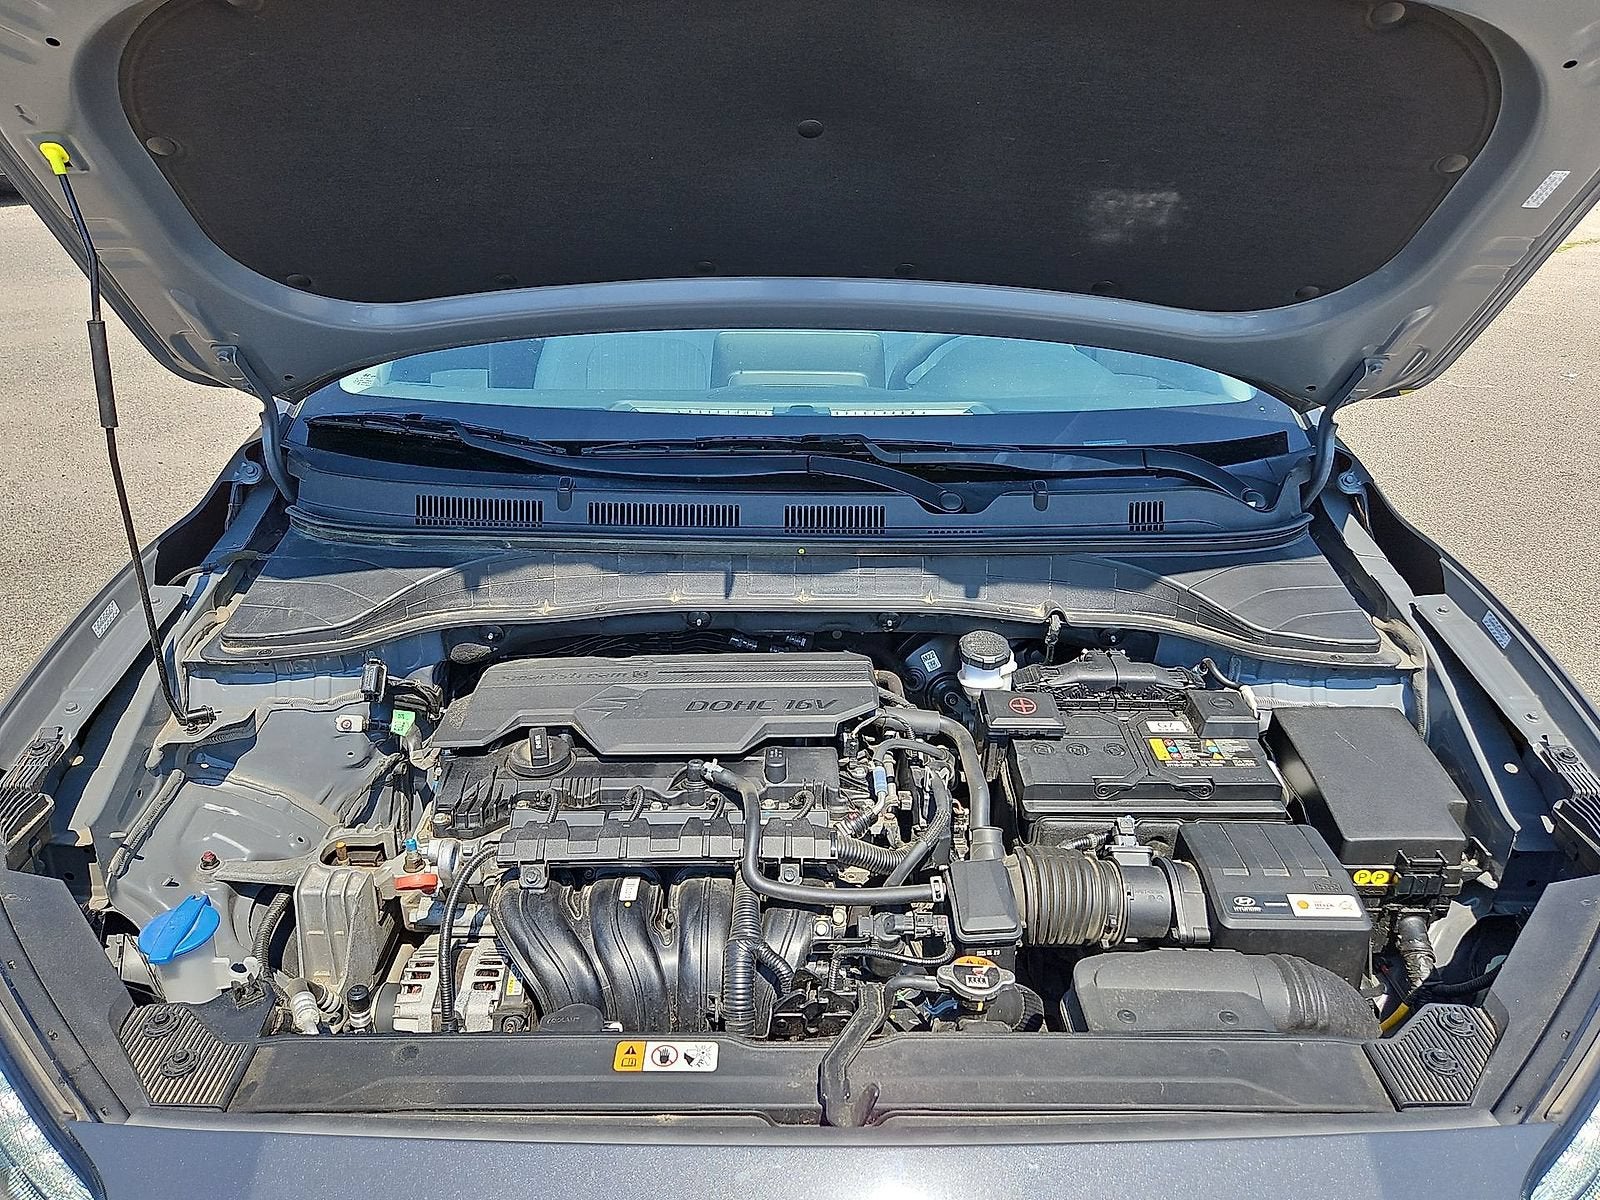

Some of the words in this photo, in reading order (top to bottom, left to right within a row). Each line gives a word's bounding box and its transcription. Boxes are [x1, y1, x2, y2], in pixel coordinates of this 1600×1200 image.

[685, 699, 777, 712] DOHC
[785, 699, 838, 710] 16V
[1358, 872, 1368, 882] P
[1375, 873, 1385, 882] P
